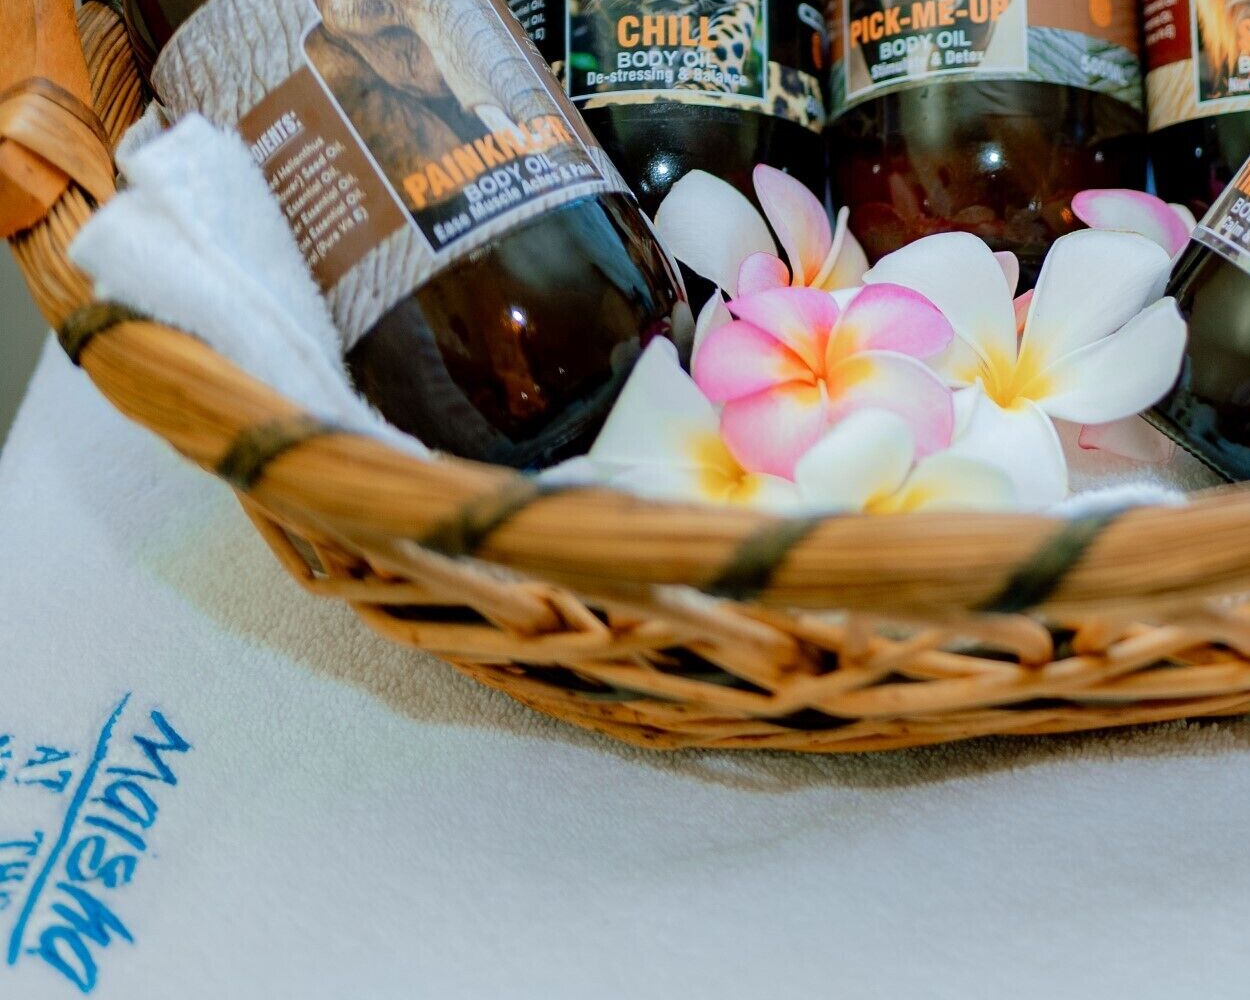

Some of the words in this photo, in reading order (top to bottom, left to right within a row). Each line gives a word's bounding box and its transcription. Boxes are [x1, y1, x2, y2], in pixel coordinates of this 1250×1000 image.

[617, 14, 719, 49] CHILL
[879, 33, 933, 61] BODY
[937, 29, 972, 48] OIL
[587, 67, 674, 86] De-stressing
[678, 67, 690, 81] &
[617, 51, 678, 68] BODY
[683, 51, 718, 70] OIL
[250, 110, 304, 165] DIENTS:
[402, 114, 575, 211] PAINKILLER
[463, 162, 522, 202] BODY
[524, 152, 558, 174] OIL
[433, 213, 472, 243] Ease
[469, 184, 522, 222] Muscle
